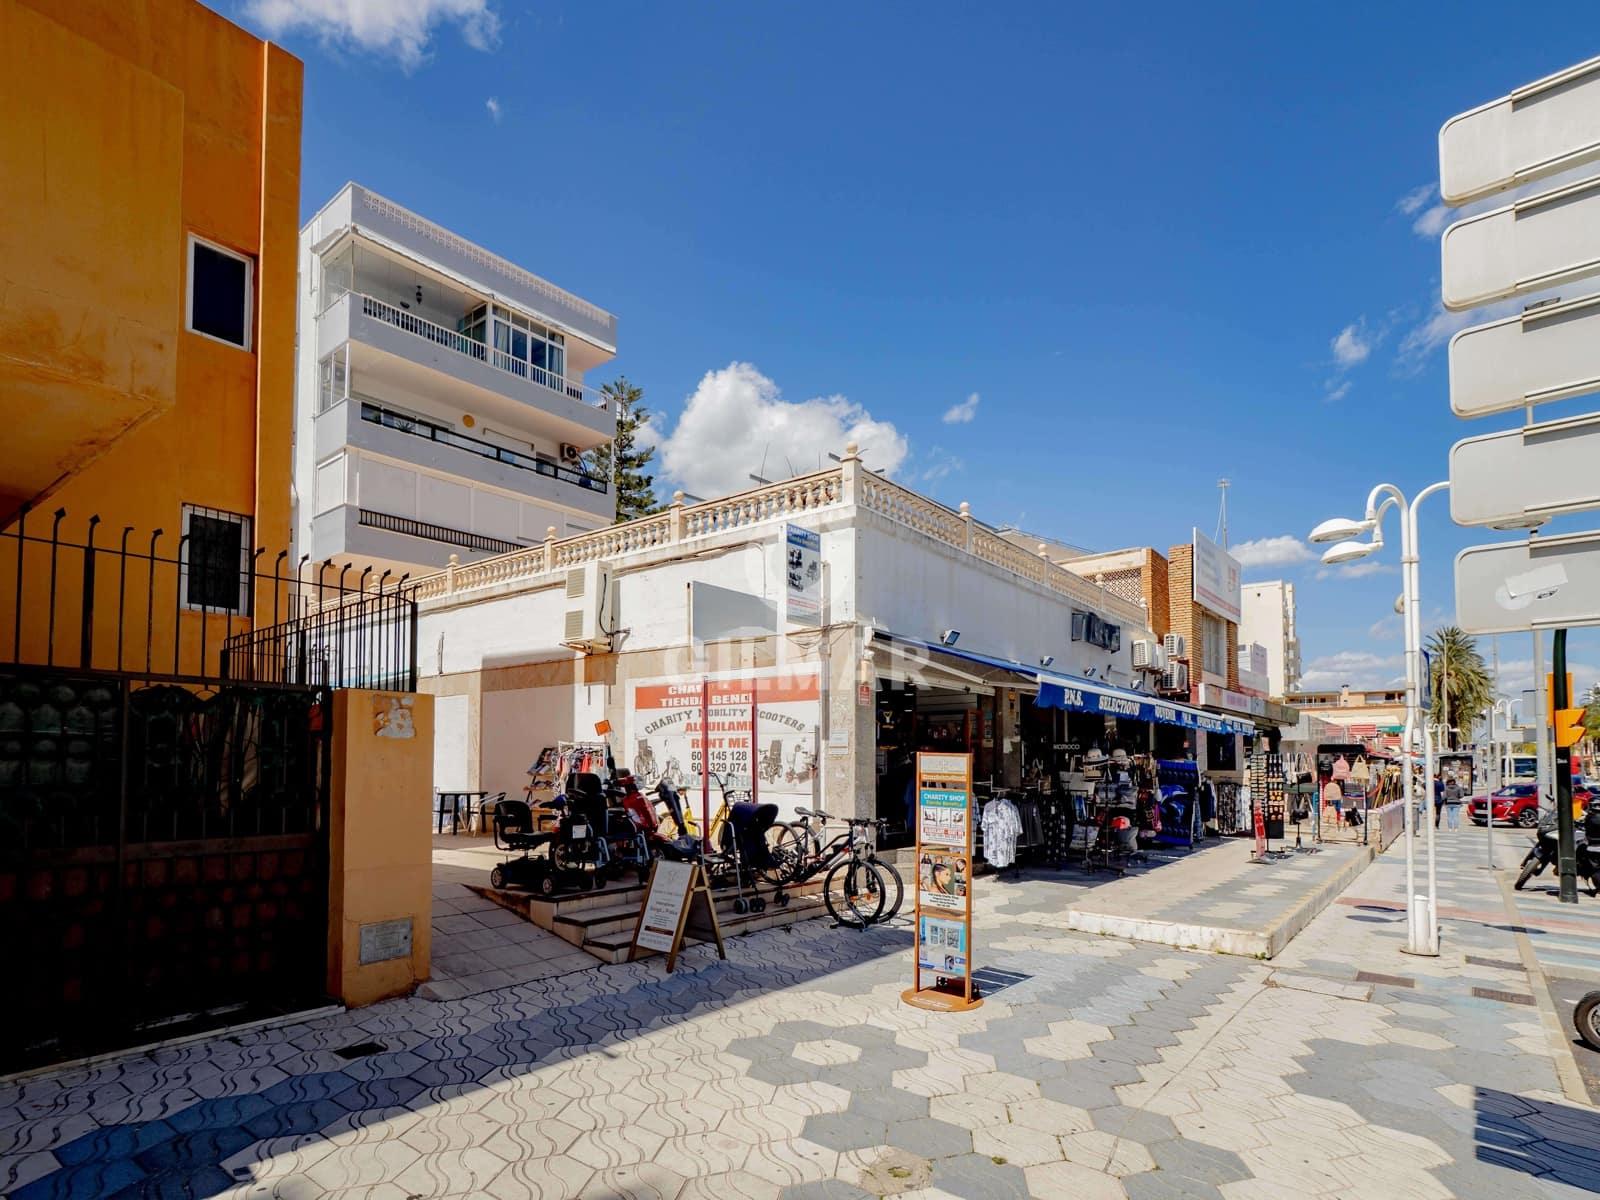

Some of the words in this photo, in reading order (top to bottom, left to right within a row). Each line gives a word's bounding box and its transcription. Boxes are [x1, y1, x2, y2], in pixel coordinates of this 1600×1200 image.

[644, 710, 693, 735] CHARITY
[757, 709, 806, 732] COOTERS
[691, 738, 725, 749] RNT
[728, 737, 749, 748] ME
[710, 751, 727, 761] 145
[730, 751, 747, 761] 128
[710, 762, 727, 772] 329
[730, 762, 747, 772] 074
[923, 793, 948, 801] CHARITY
[949, 795, 965, 803] SHOP
